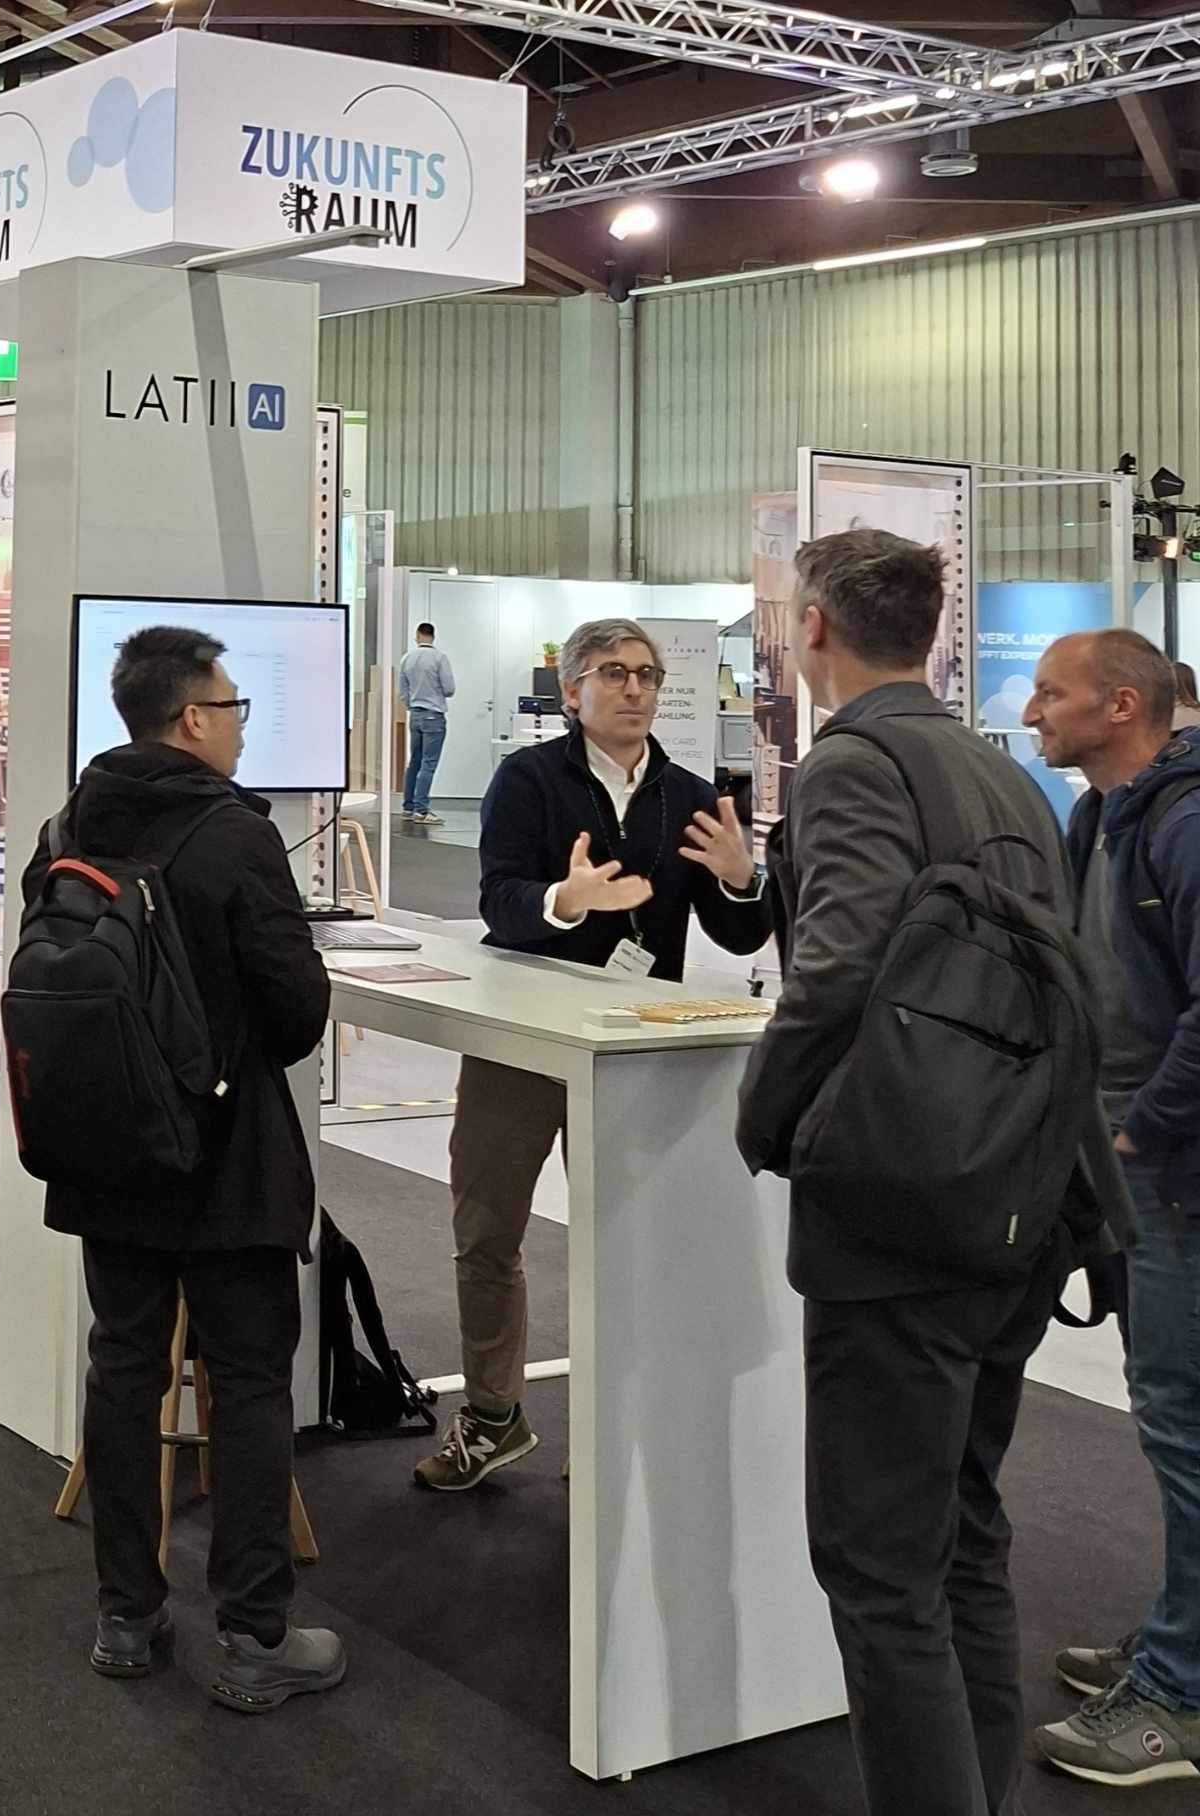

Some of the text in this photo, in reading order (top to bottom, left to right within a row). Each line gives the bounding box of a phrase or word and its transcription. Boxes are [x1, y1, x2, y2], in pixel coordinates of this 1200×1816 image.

[240, 124, 446, 200] ZUKUNFTS
[106, 369, 281, 428] LATII AI
[656, 712, 696, 721] AHLUNG
